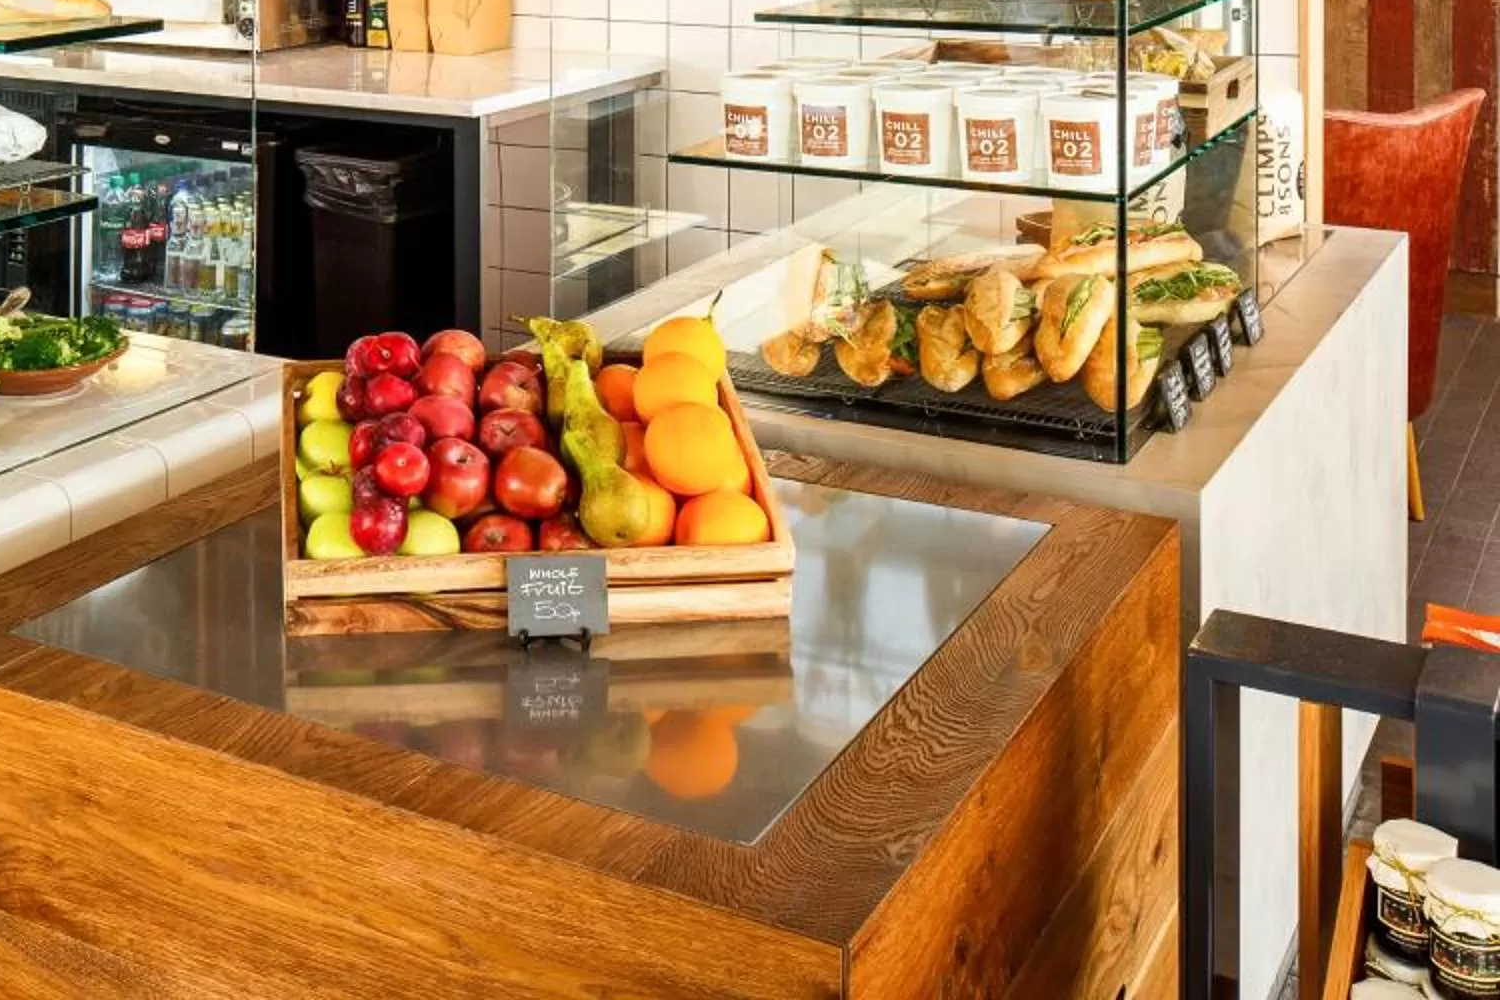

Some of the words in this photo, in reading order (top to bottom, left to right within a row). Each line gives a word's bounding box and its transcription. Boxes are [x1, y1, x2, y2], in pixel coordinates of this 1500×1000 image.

[885, 119, 921, 132] CHILL
[970, 126, 1008, 139] CHILL
[1053, 128, 1092, 142] CHILL
[528, 567, 581, 581] WHOLE
